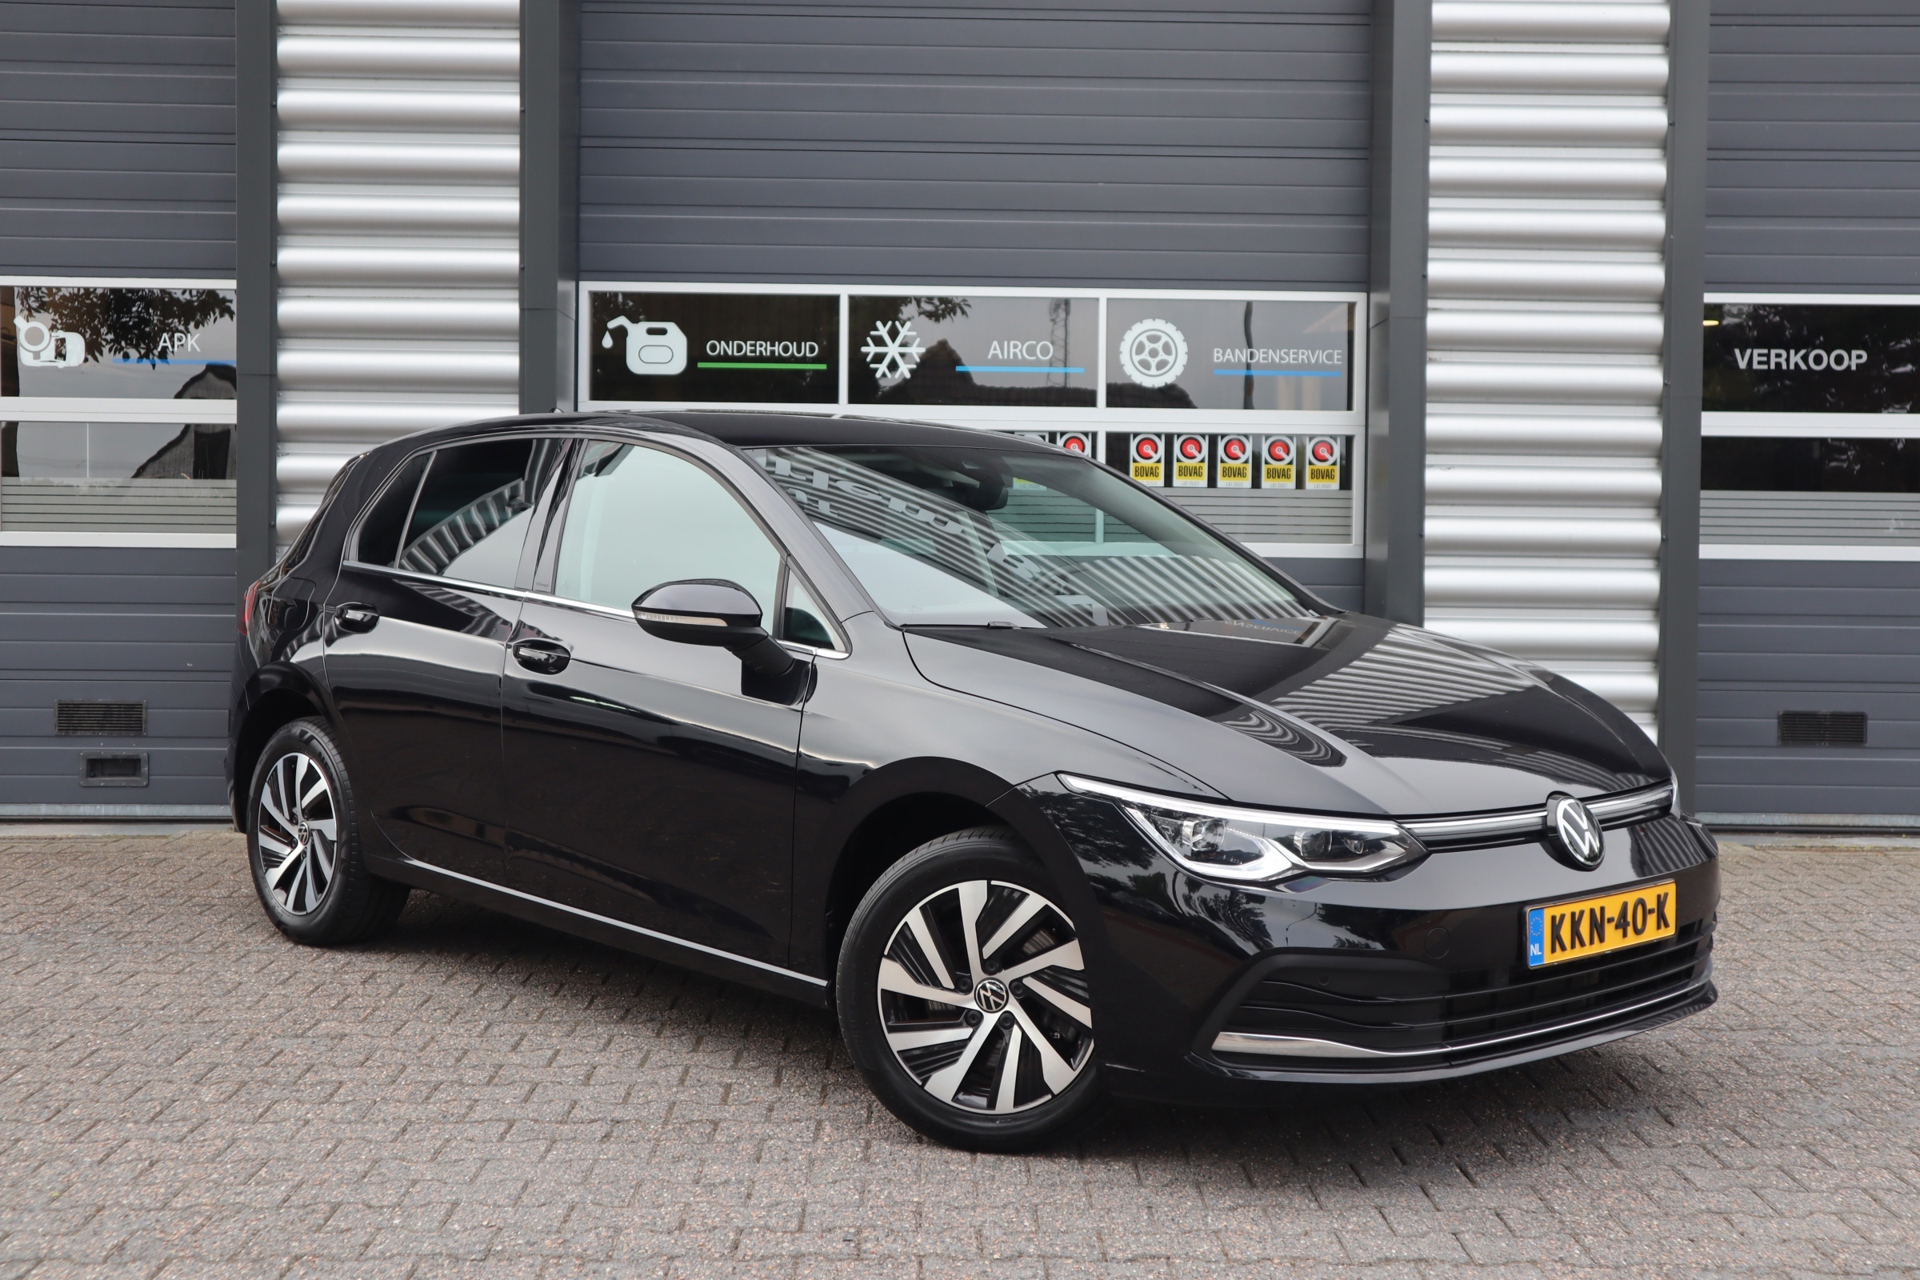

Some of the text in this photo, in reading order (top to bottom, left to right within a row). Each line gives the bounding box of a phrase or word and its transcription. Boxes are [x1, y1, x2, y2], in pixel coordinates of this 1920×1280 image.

[157, 332, 201, 353] APK
[705, 340, 819, 357] ONDERHOUD
[987, 340, 1054, 360] AIRCO
[1213, 347, 1343, 365] BANDENSERVICE
[1734, 348, 1868, 371] VERKOOP
[1134, 465, 1160, 478] BOVAG
[1178, 465, 1204, 478] BOVAG
[1222, 466, 1247, 478] BOVAG
[1266, 467, 1292, 480] BOVAG
[1310, 468, 1336, 480] BOVAG
[1551, 892, 1670, 954] KKN-40-K
[1530, 943, 1542, 956] NL
